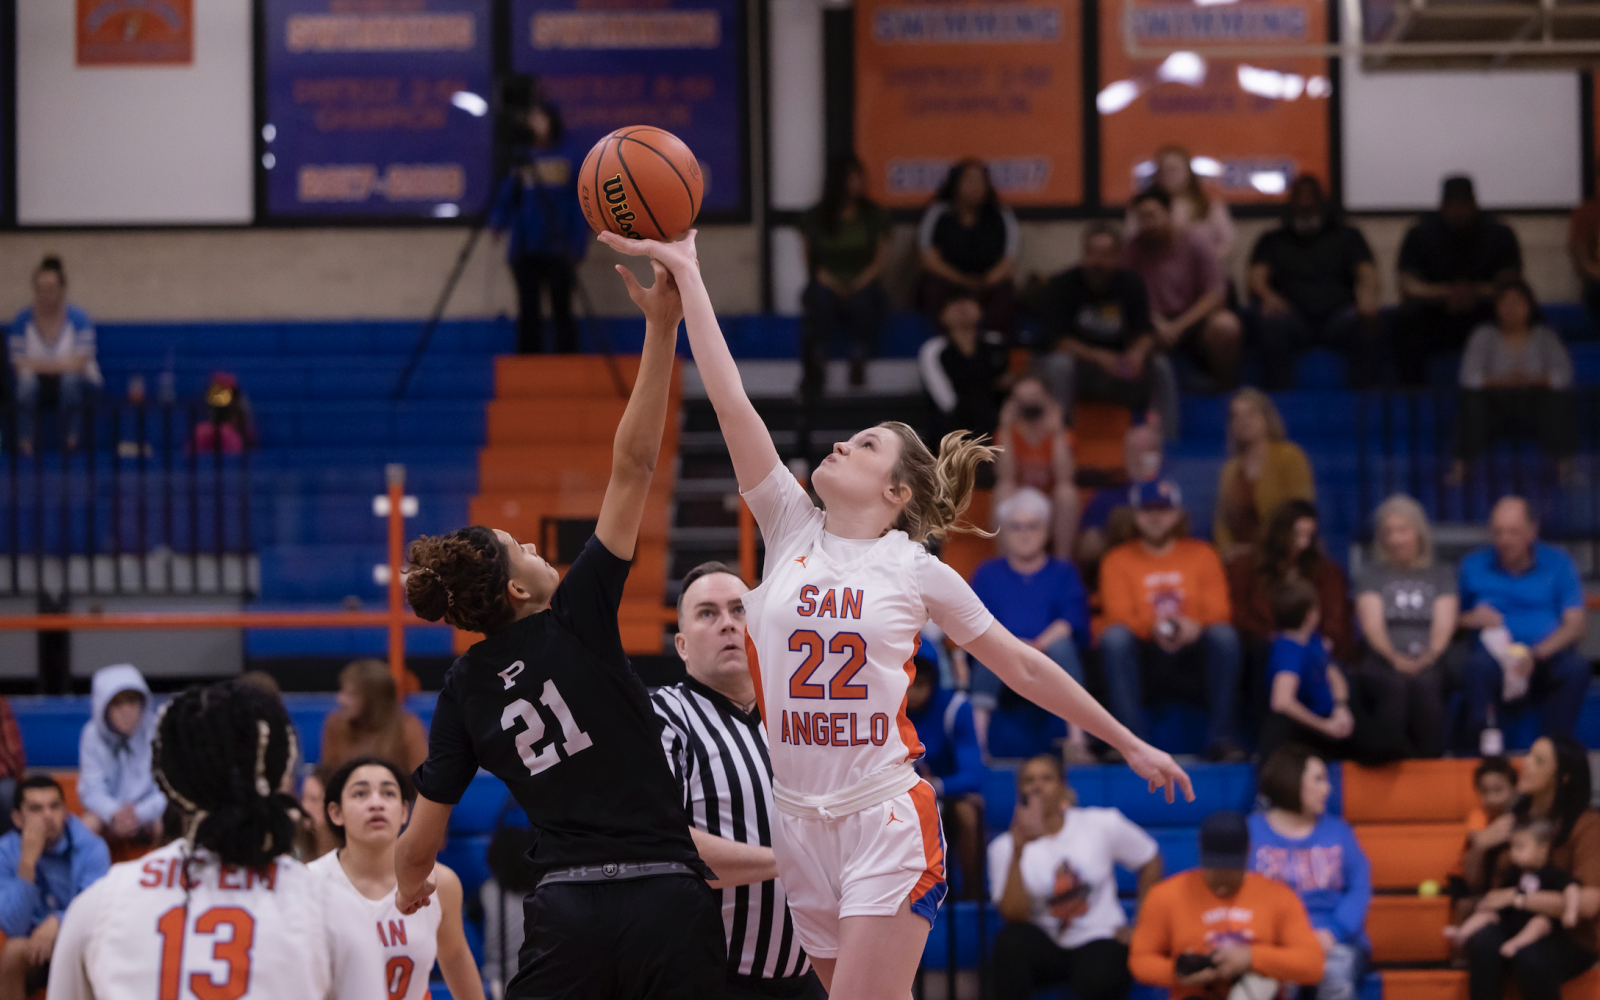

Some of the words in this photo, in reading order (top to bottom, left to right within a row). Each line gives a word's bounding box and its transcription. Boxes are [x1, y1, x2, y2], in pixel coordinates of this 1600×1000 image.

[603, 173, 643, 239] Wilso
[797, 584, 863, 619] SAN
[497, 660, 525, 691] P
[788, 629, 868, 700] 22
[500, 678, 594, 777] 21
[781, 709, 889, 747] ANGELO
[156, 904, 256, 1000] 13
